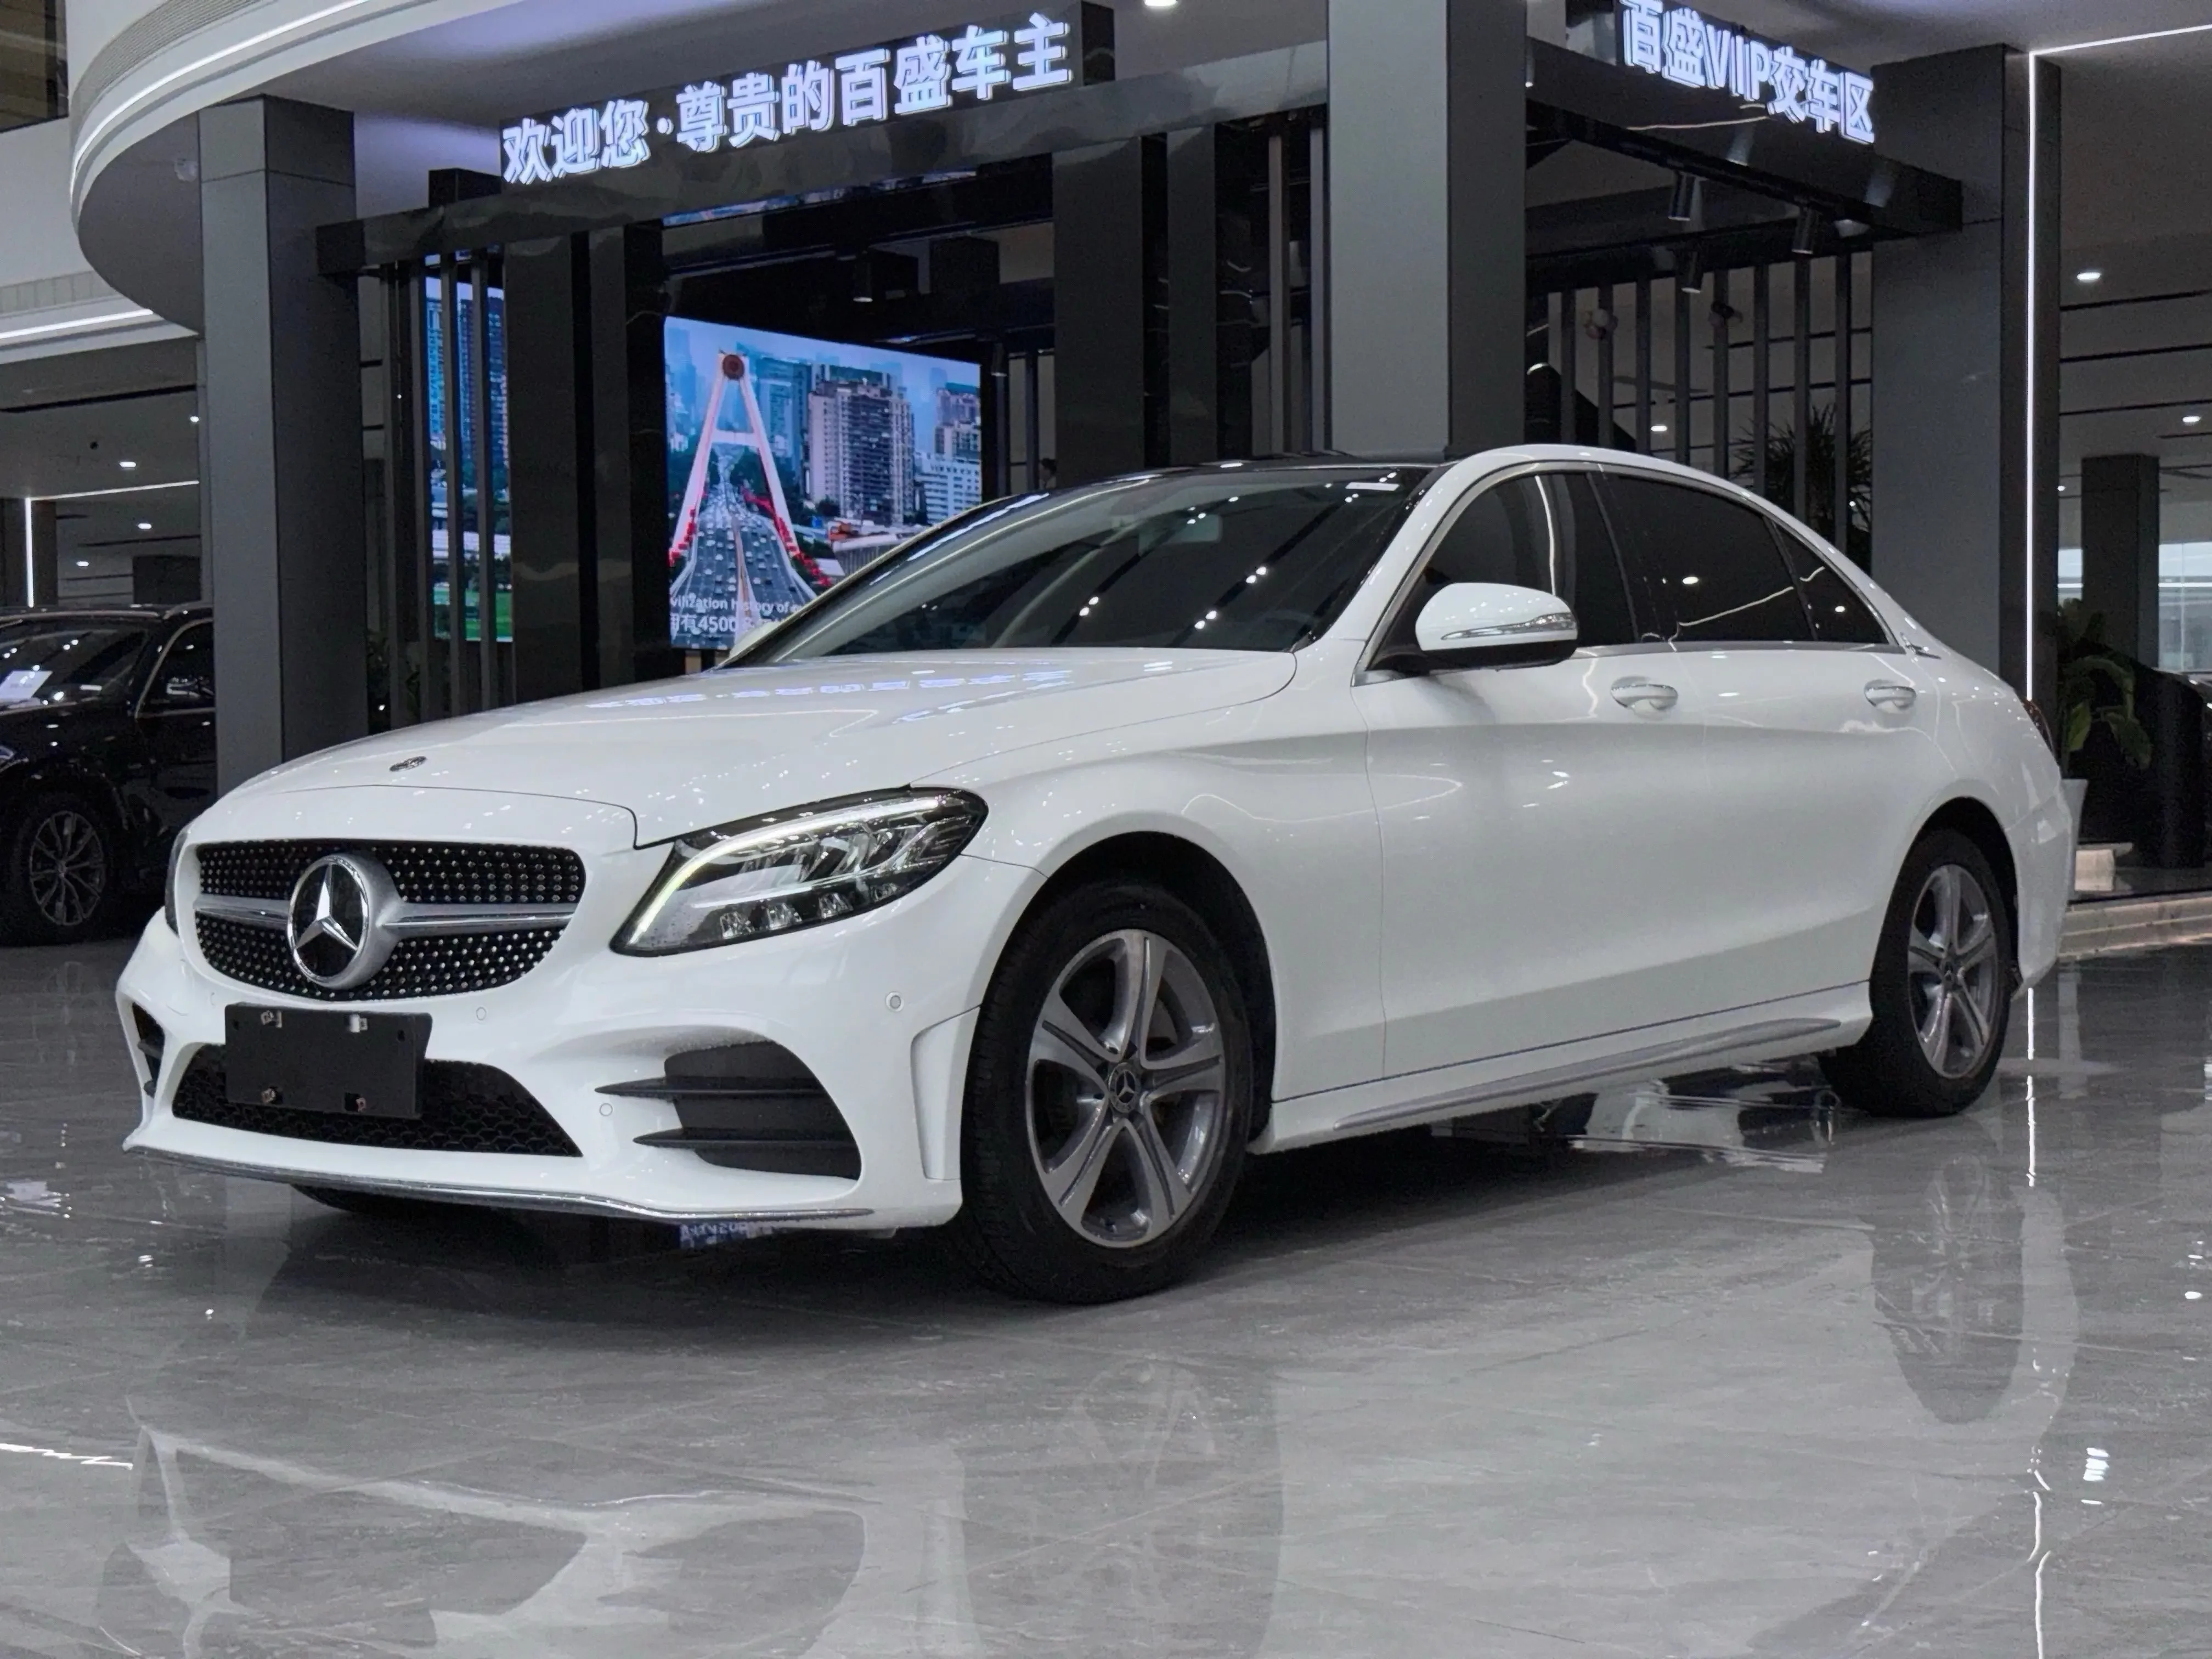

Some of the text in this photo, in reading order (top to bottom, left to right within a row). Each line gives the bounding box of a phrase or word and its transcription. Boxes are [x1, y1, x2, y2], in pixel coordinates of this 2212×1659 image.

[502, 13, 1073, 185] 欢迎您·尊贵的百盛车主
[1620, 0, 1875, 144] 百盛VIP交车区
[776, 601, 789, 613] of
